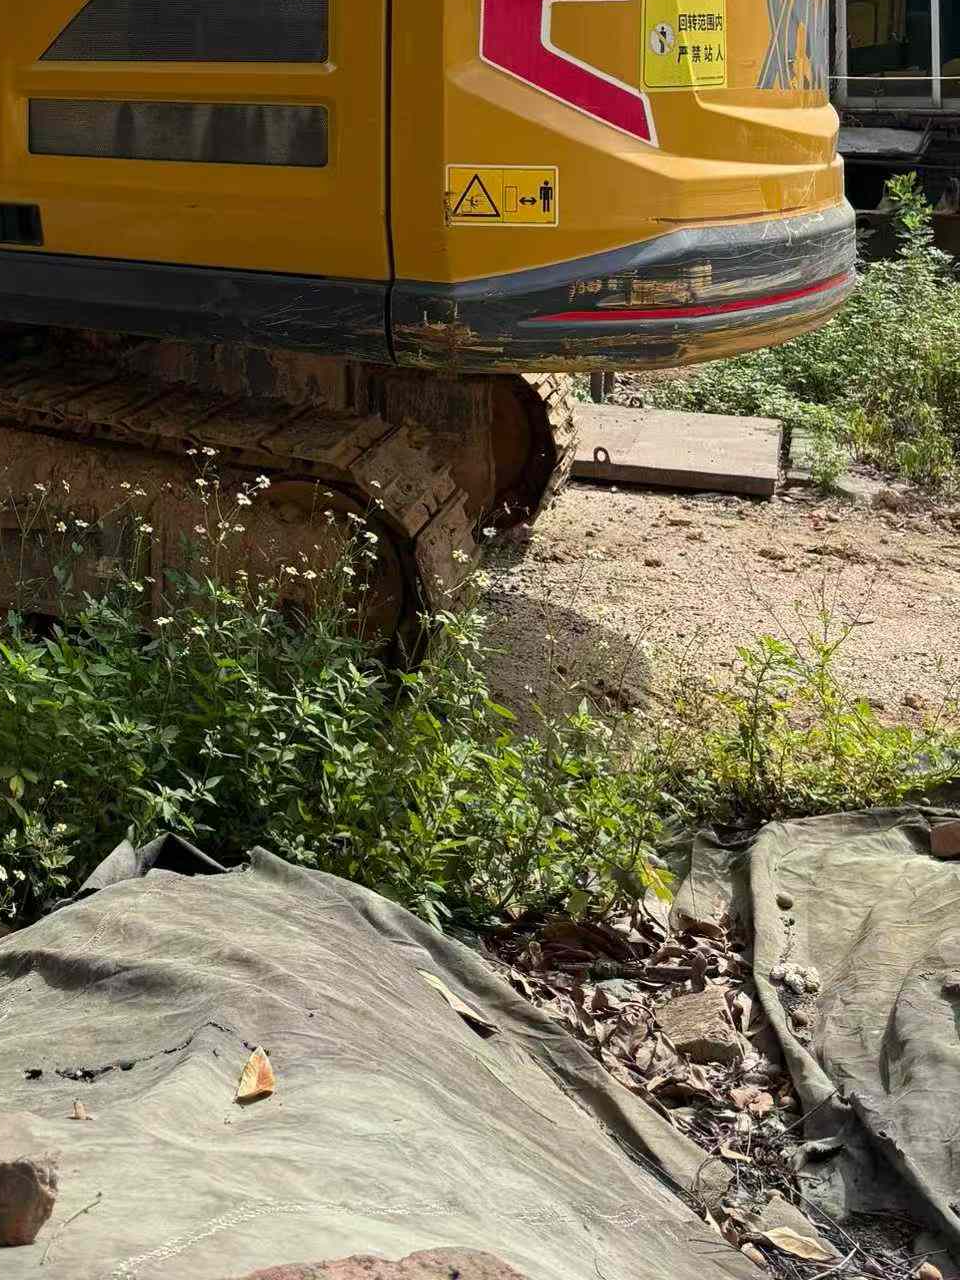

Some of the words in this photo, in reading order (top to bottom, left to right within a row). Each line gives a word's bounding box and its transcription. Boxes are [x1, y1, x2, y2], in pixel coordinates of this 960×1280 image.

[678, 13, 723, 32] 回转范围内
[677, 44, 724, 63] 严禁站人
